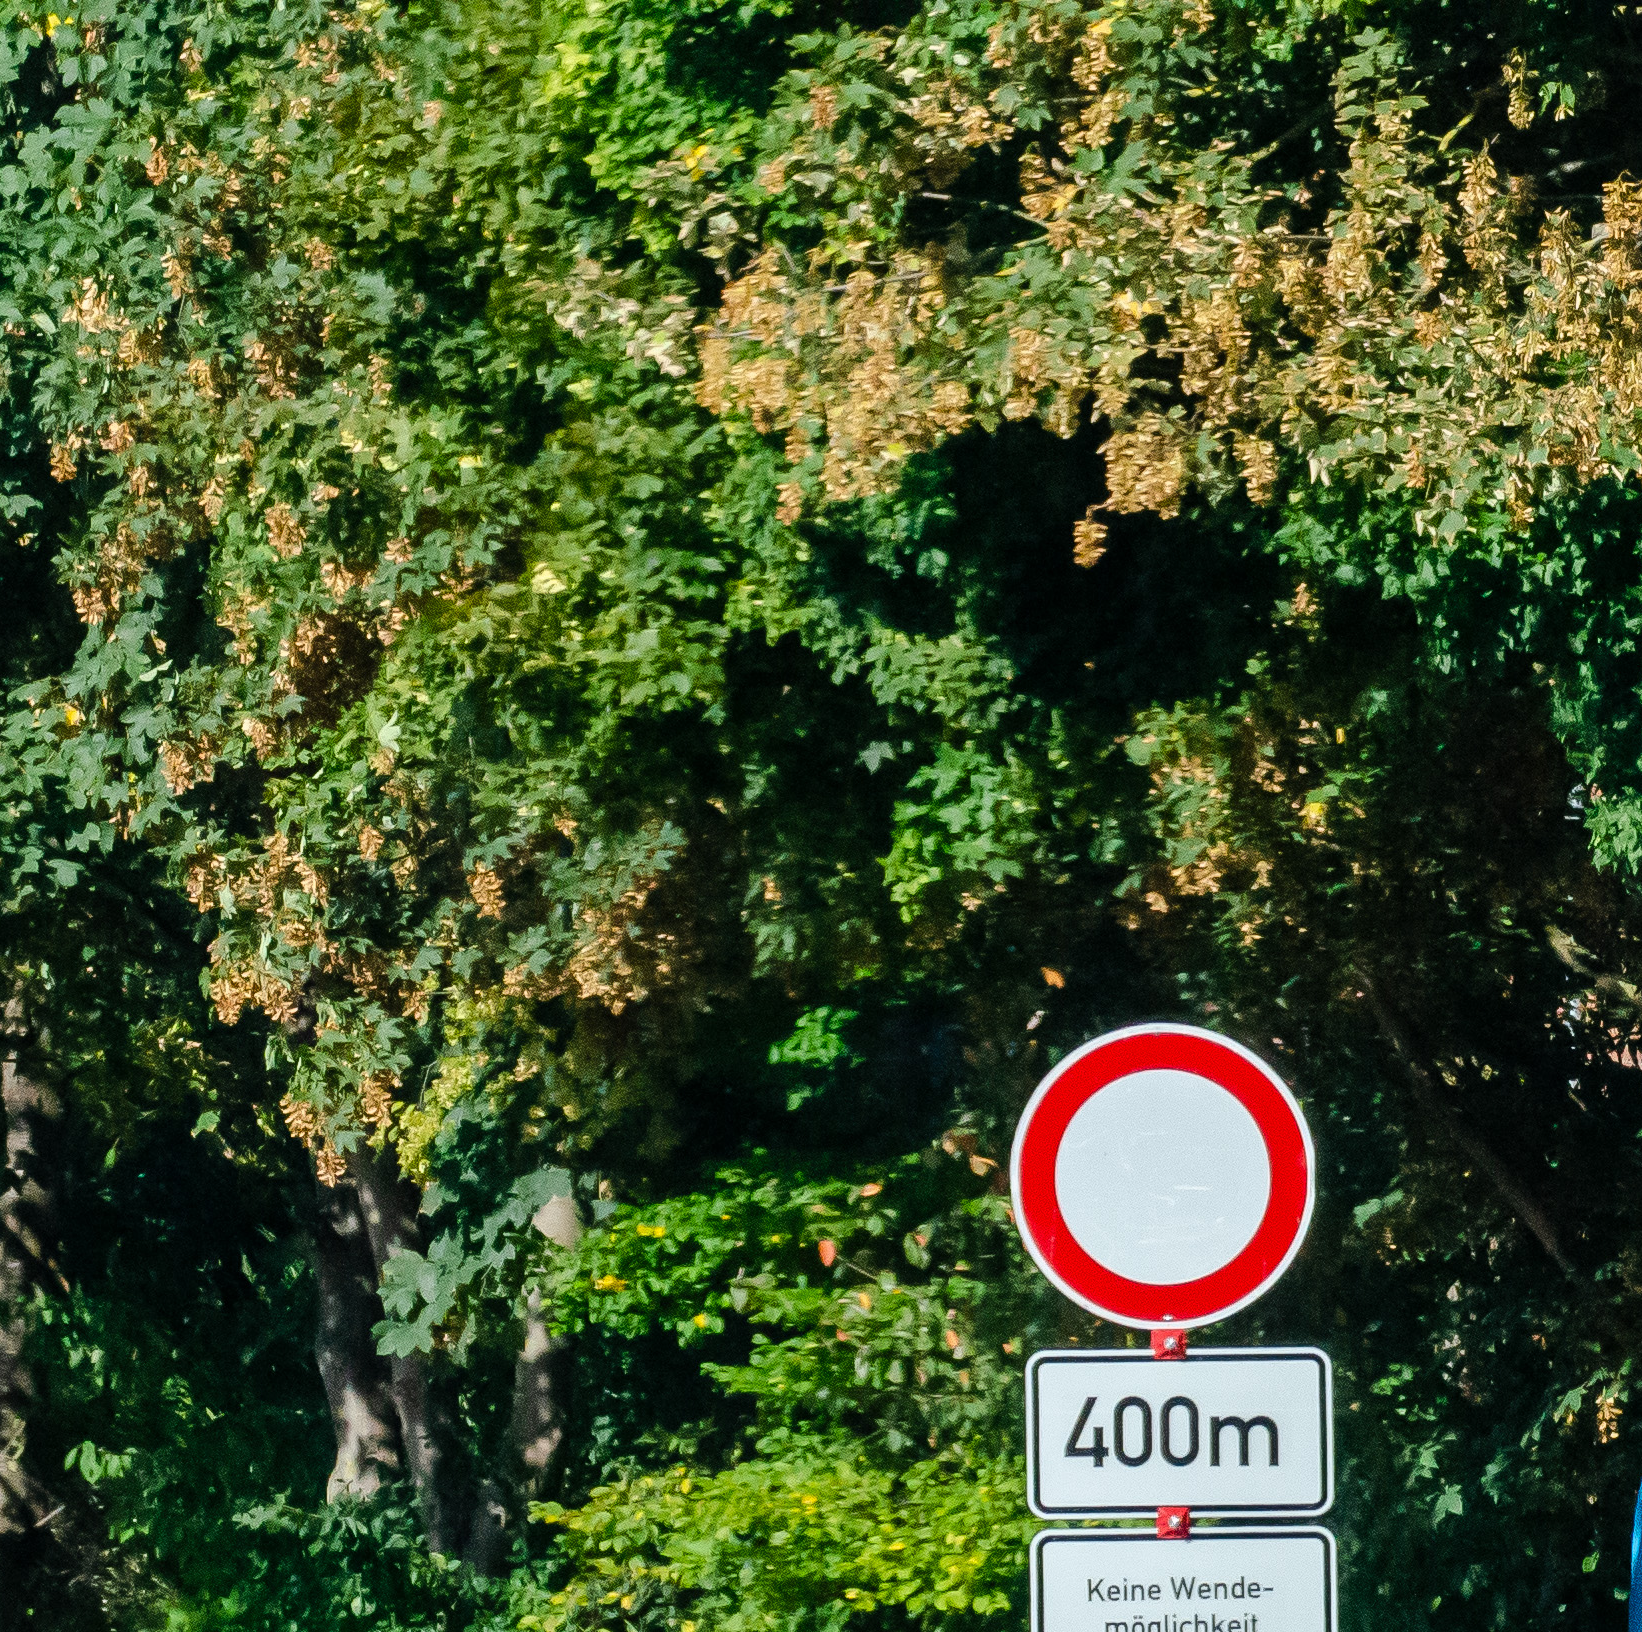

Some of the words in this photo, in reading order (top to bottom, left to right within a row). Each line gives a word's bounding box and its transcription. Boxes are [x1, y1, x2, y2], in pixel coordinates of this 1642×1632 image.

[1064, 1395, 1279, 1467] 400m
[1087, 1577, 1161, 1602] Keine
[1170, 1575, 1274, 1600] Wende-
